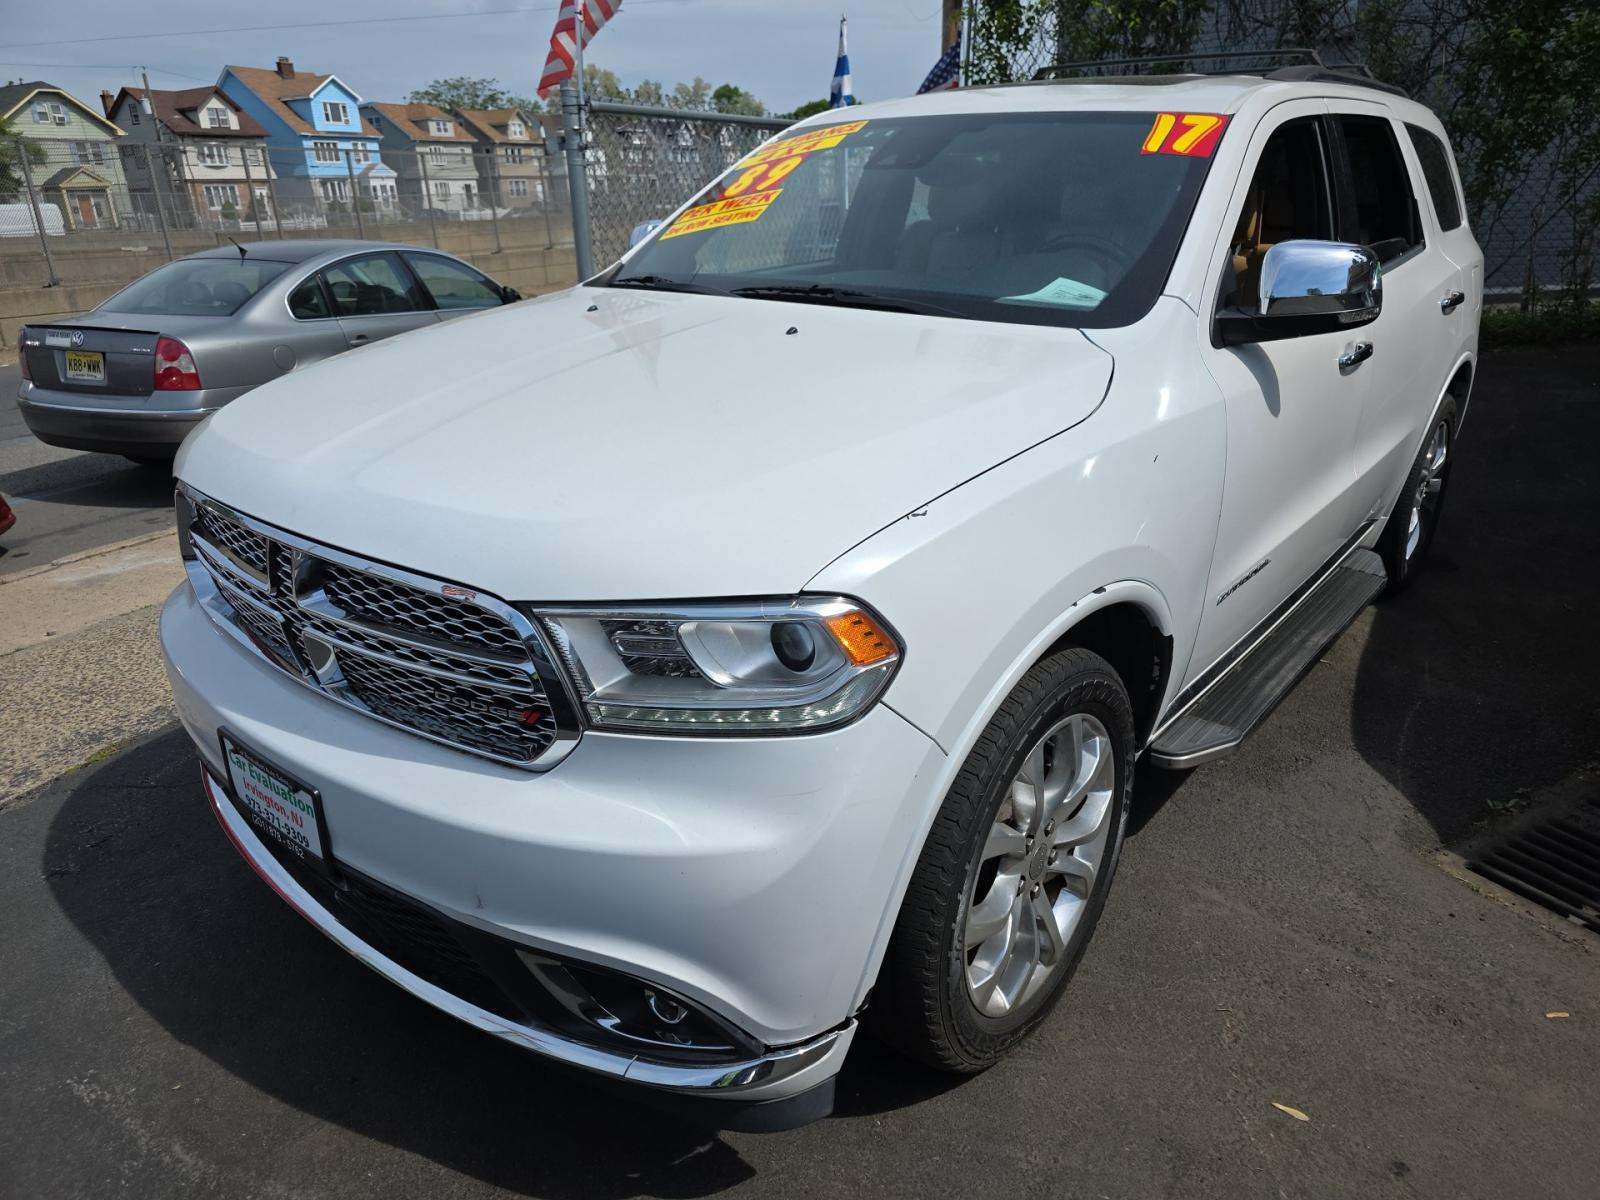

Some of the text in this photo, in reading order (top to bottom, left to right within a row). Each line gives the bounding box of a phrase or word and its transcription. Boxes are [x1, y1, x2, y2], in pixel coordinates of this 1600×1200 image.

[1142, 113, 1222, 154] 17
[724, 156, 803, 199] 89
[679, 190, 778, 220] PER WEEK
[249, 763, 315, 818] Evaluation
[290, 810, 304, 829] NJ
